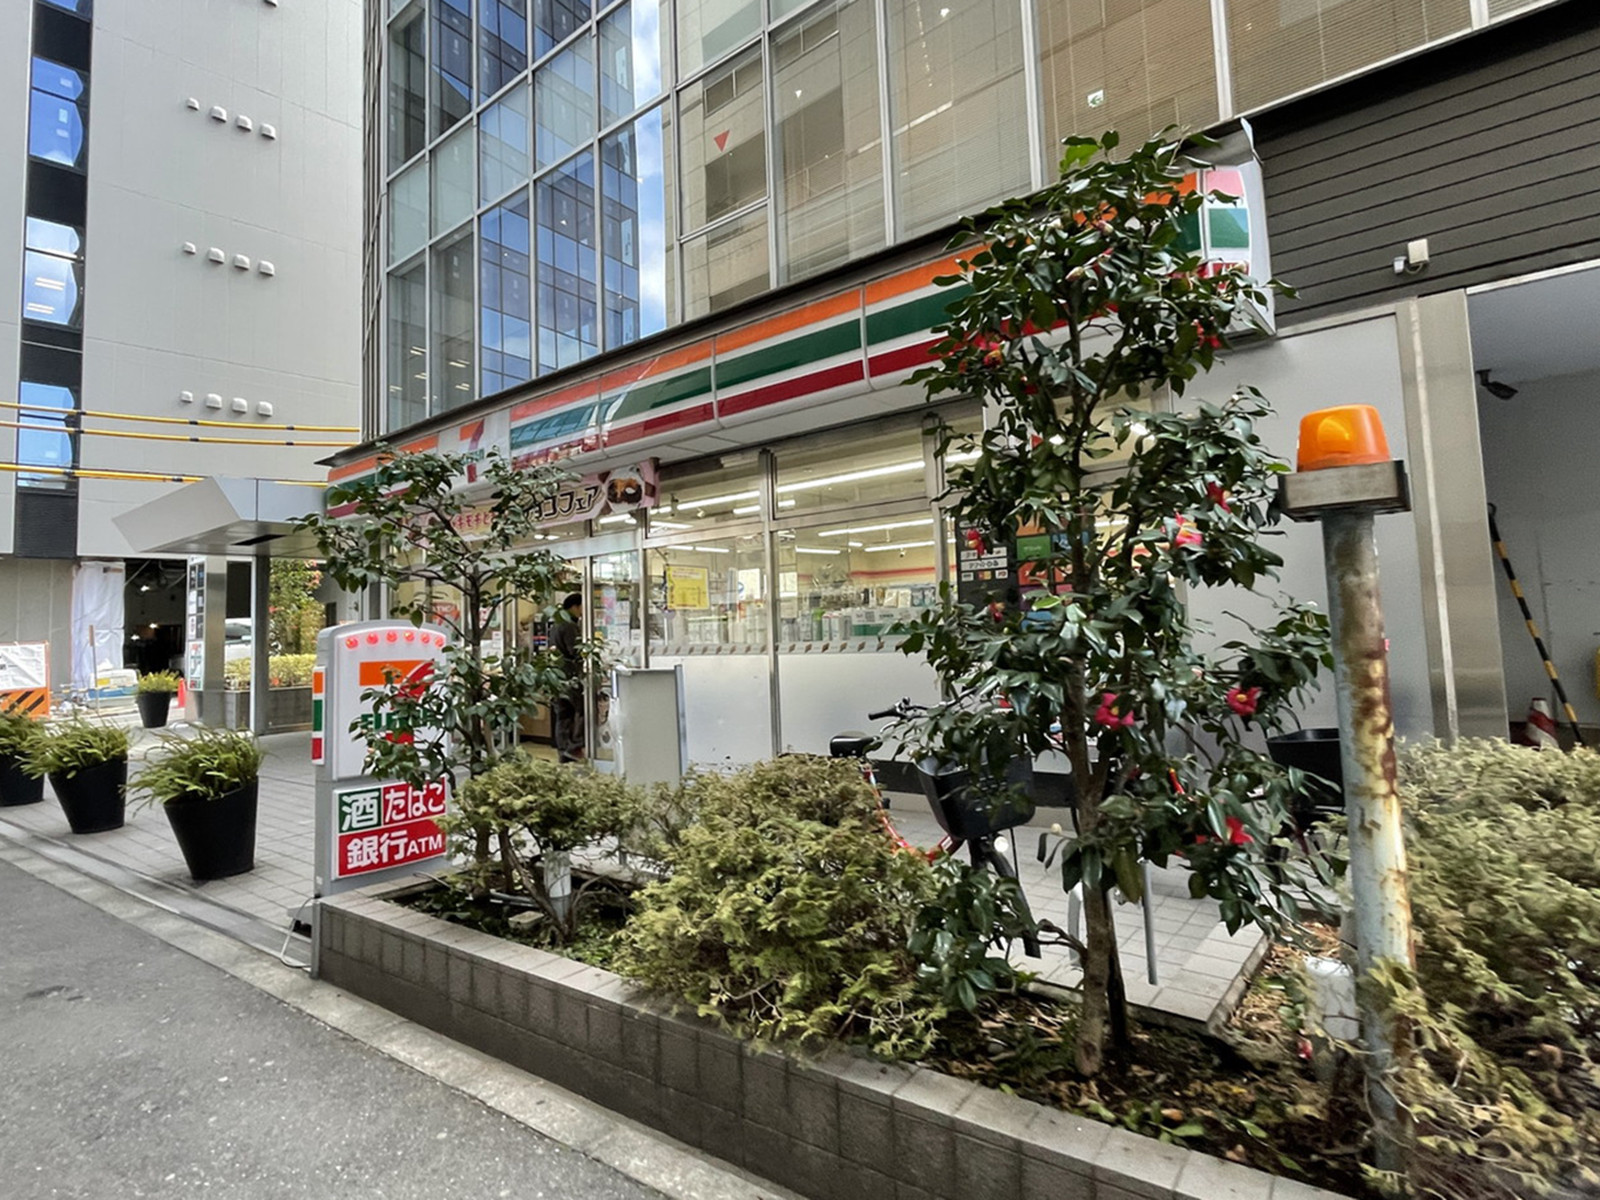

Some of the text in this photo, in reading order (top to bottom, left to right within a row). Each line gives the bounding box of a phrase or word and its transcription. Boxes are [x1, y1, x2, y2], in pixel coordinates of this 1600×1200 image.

[341, 782, 445, 831] 酒 たばこ
